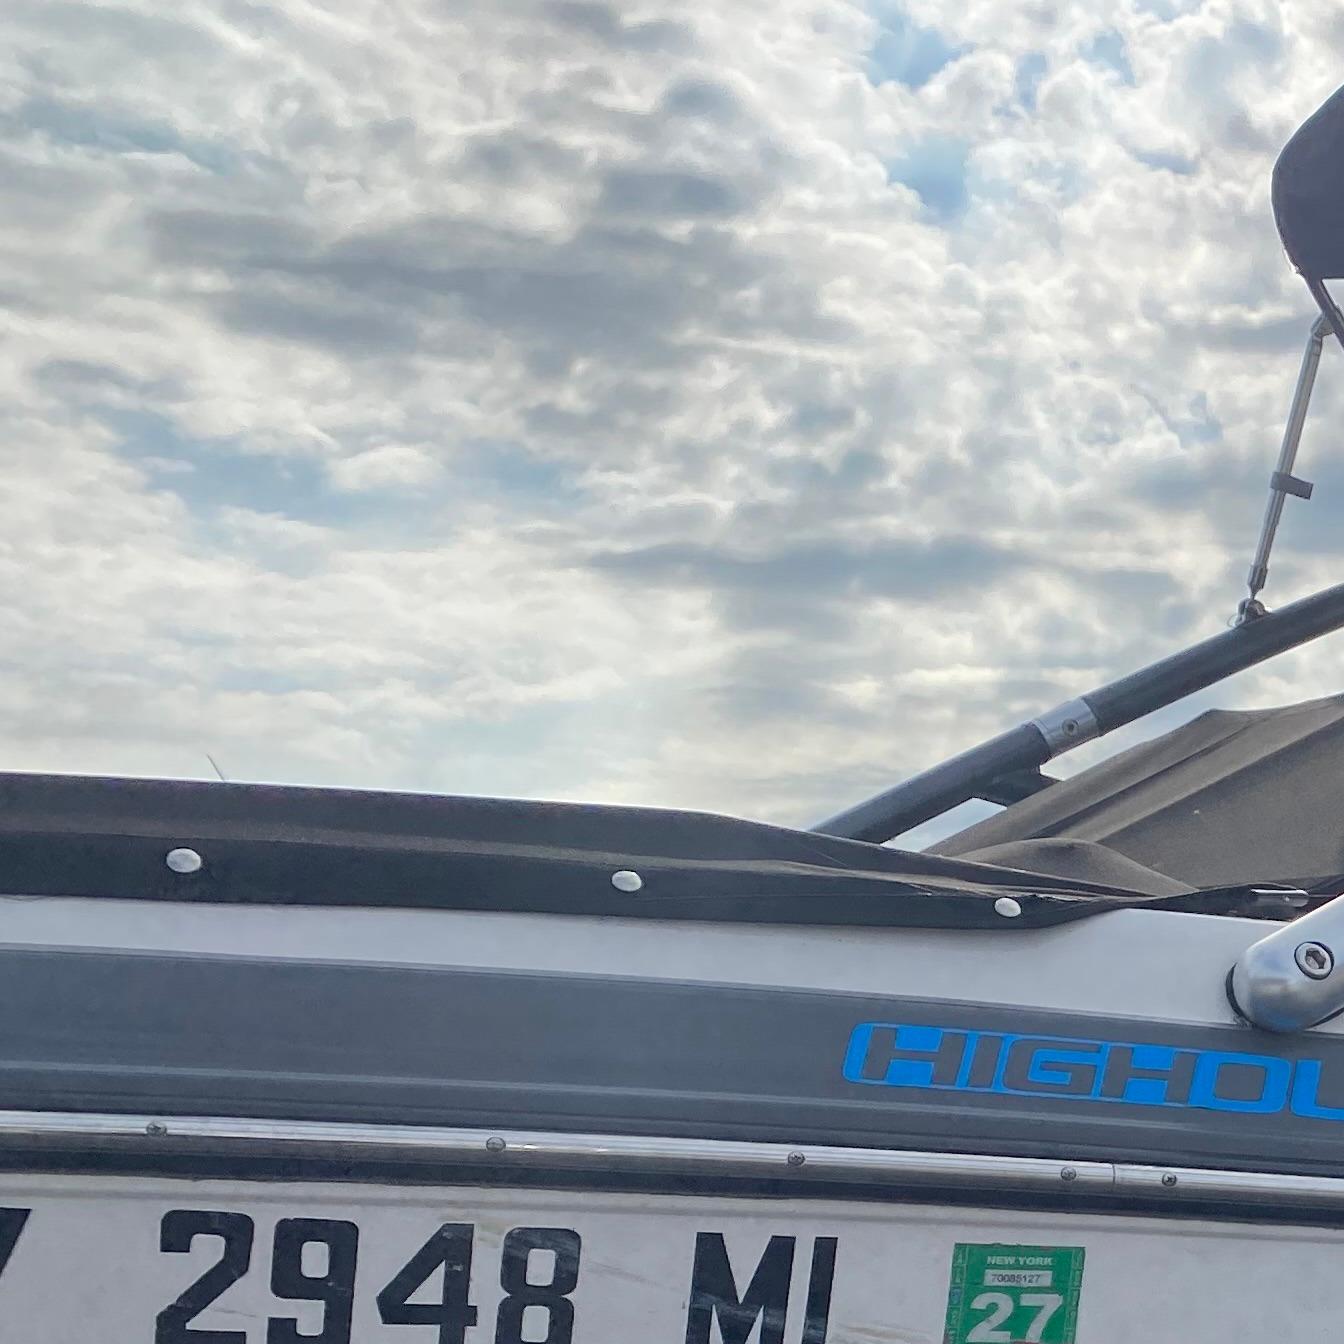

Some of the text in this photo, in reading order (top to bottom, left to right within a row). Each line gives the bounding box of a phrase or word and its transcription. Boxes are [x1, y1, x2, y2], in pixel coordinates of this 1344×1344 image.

[986, 1255, 1053, 1266] NEW YORK
[966, 1292, 1063, 1343] 27
